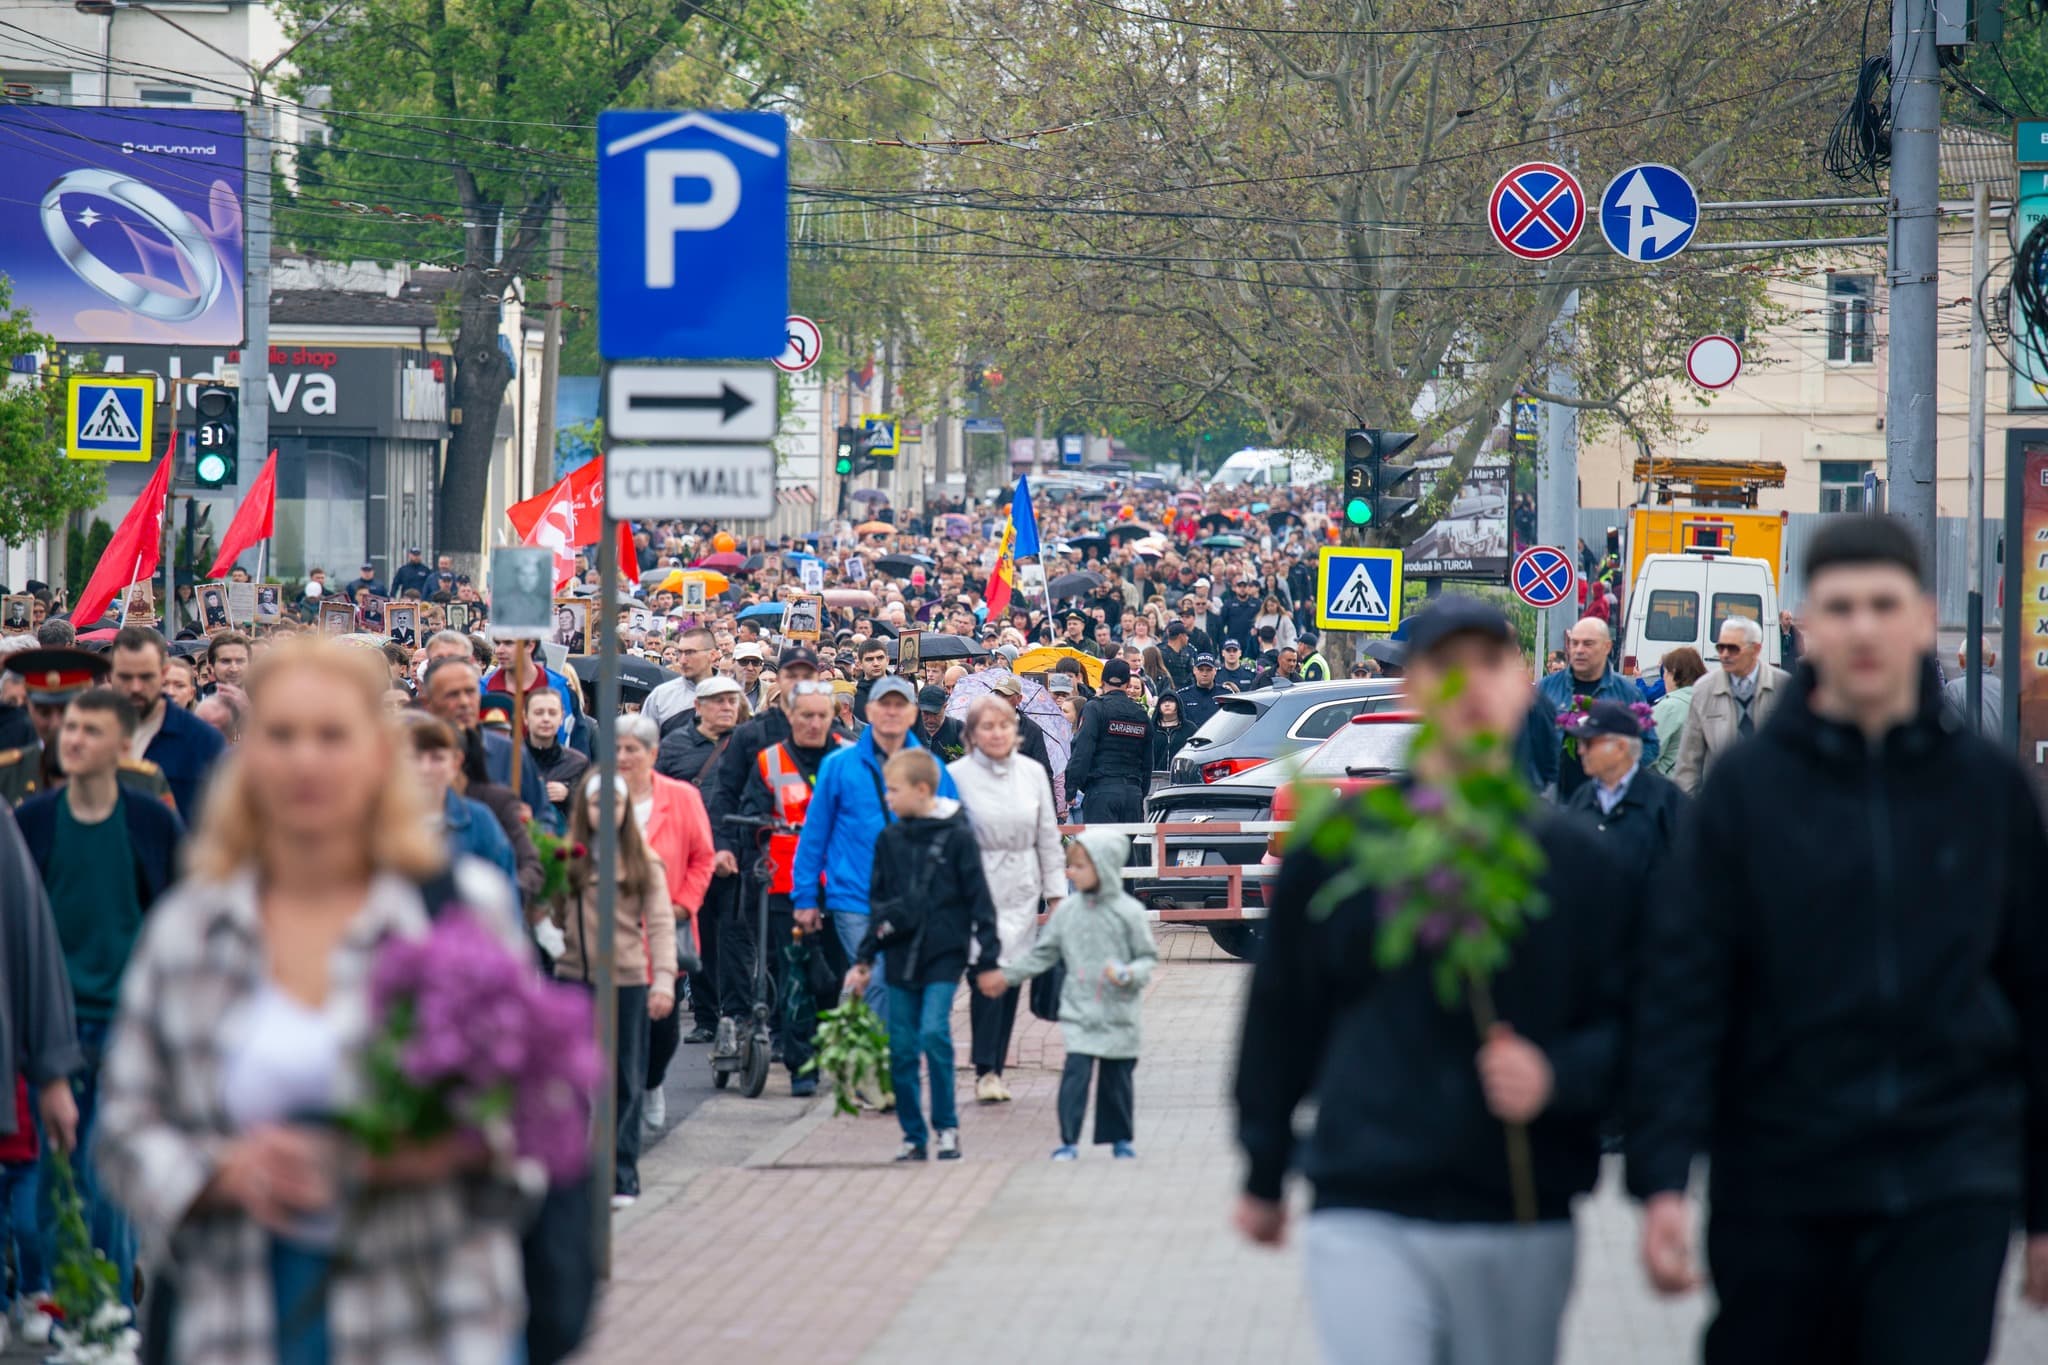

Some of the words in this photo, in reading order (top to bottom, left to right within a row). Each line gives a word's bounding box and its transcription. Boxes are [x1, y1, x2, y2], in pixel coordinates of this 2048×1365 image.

[644, 149, 742, 289] P
[292, 346, 337, 370] shop
[202, 426, 223, 445] 31
[1474, 469, 1494, 479] Mare
[1443, 560, 1473, 570] TURCIA
